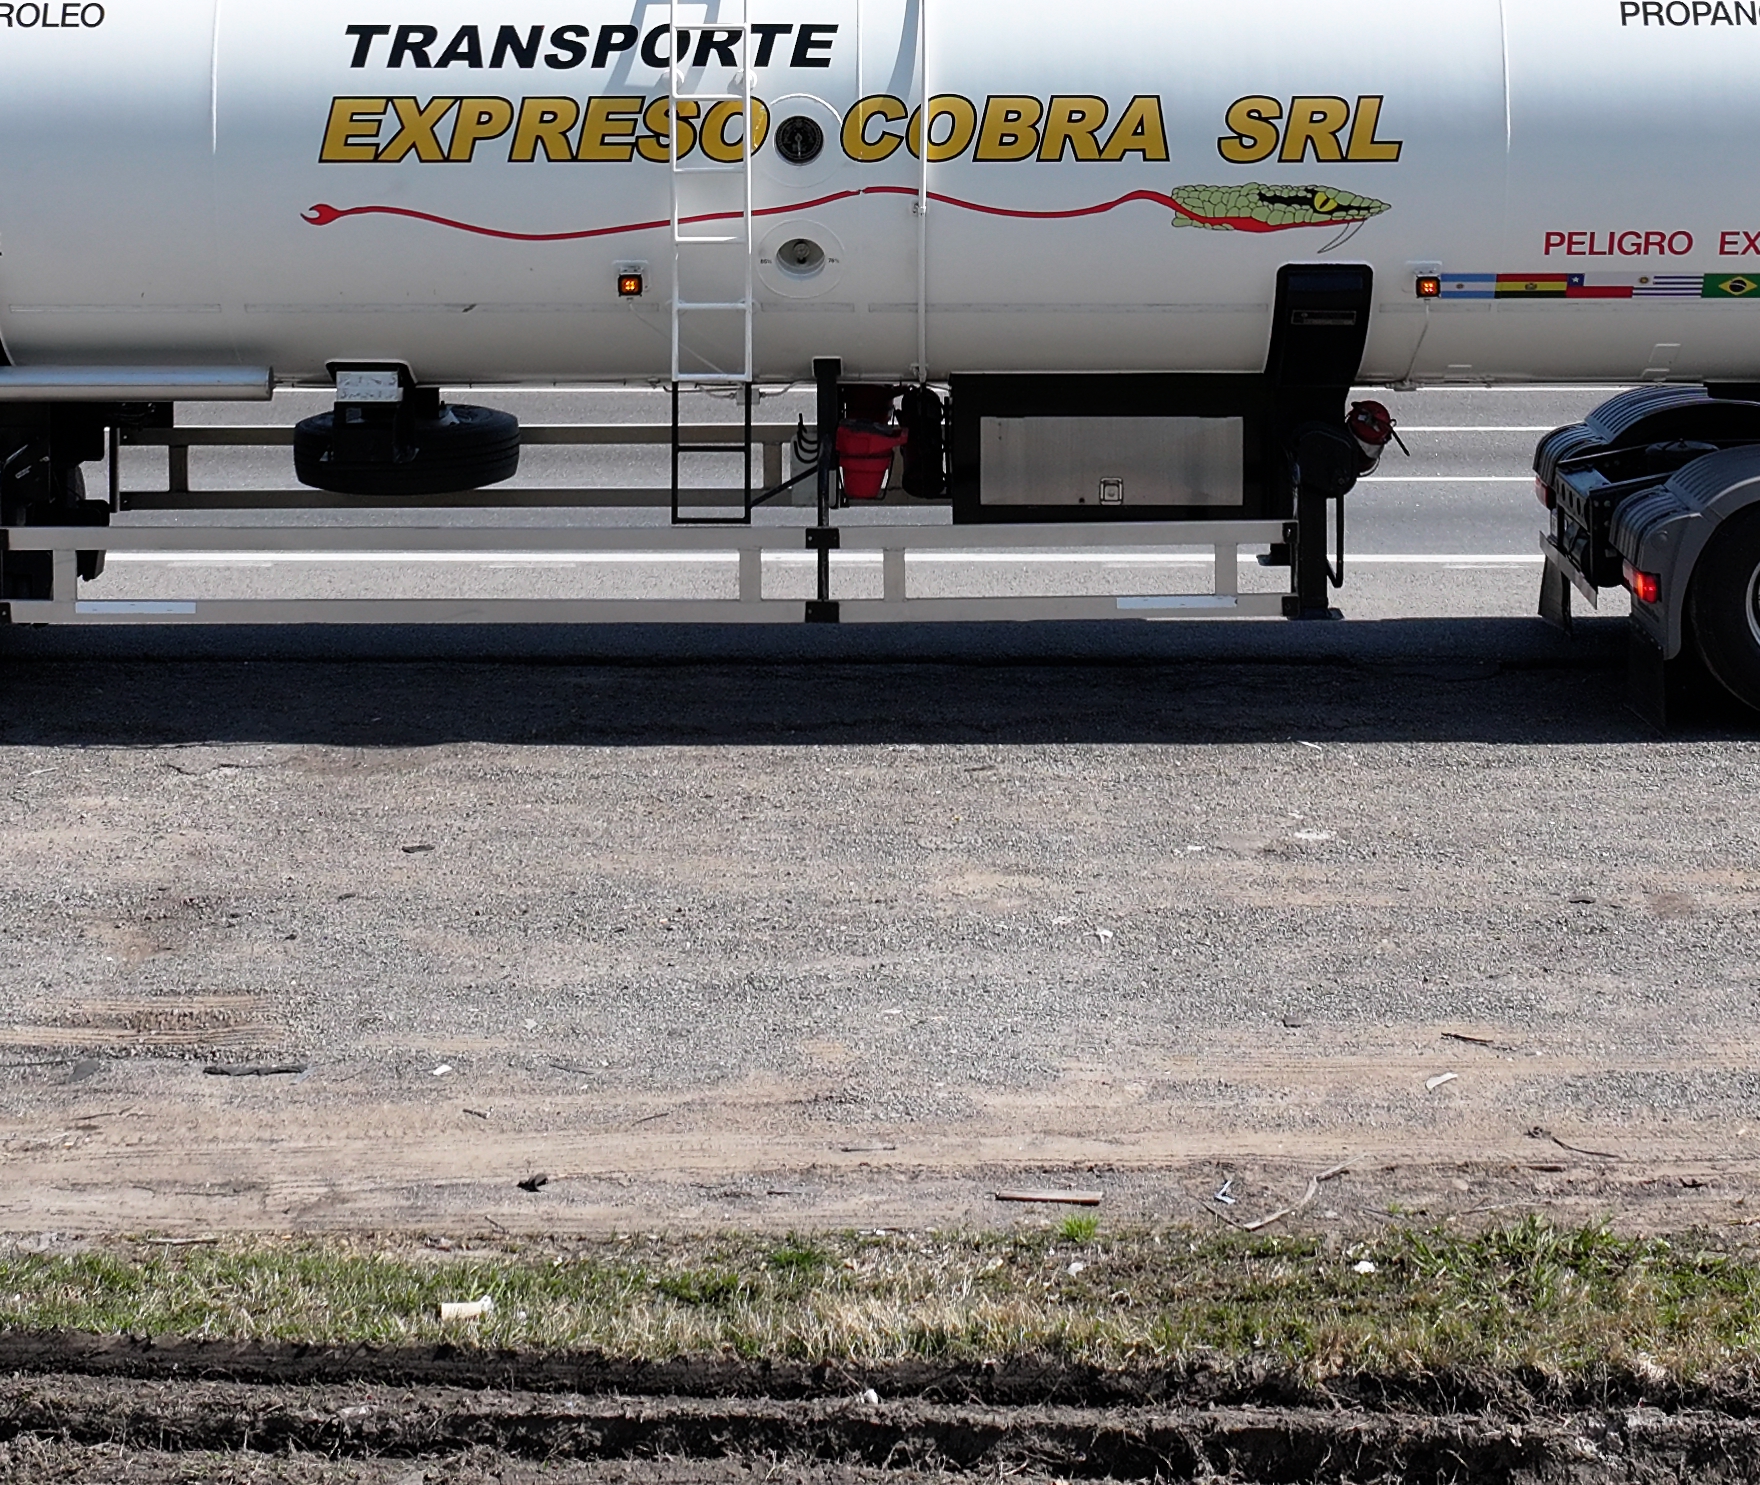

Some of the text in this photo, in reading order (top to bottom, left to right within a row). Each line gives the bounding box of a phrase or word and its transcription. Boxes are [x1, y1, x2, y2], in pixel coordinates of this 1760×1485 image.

[345, 23, 840, 70] TRANSPORTE
[318, 95, 771, 164] EXPRESO
[840, 95, 1170, 163] COBRA
[1217, 95, 1404, 163] SRL
[1544, 230, 1694, 256] PELIGRO
